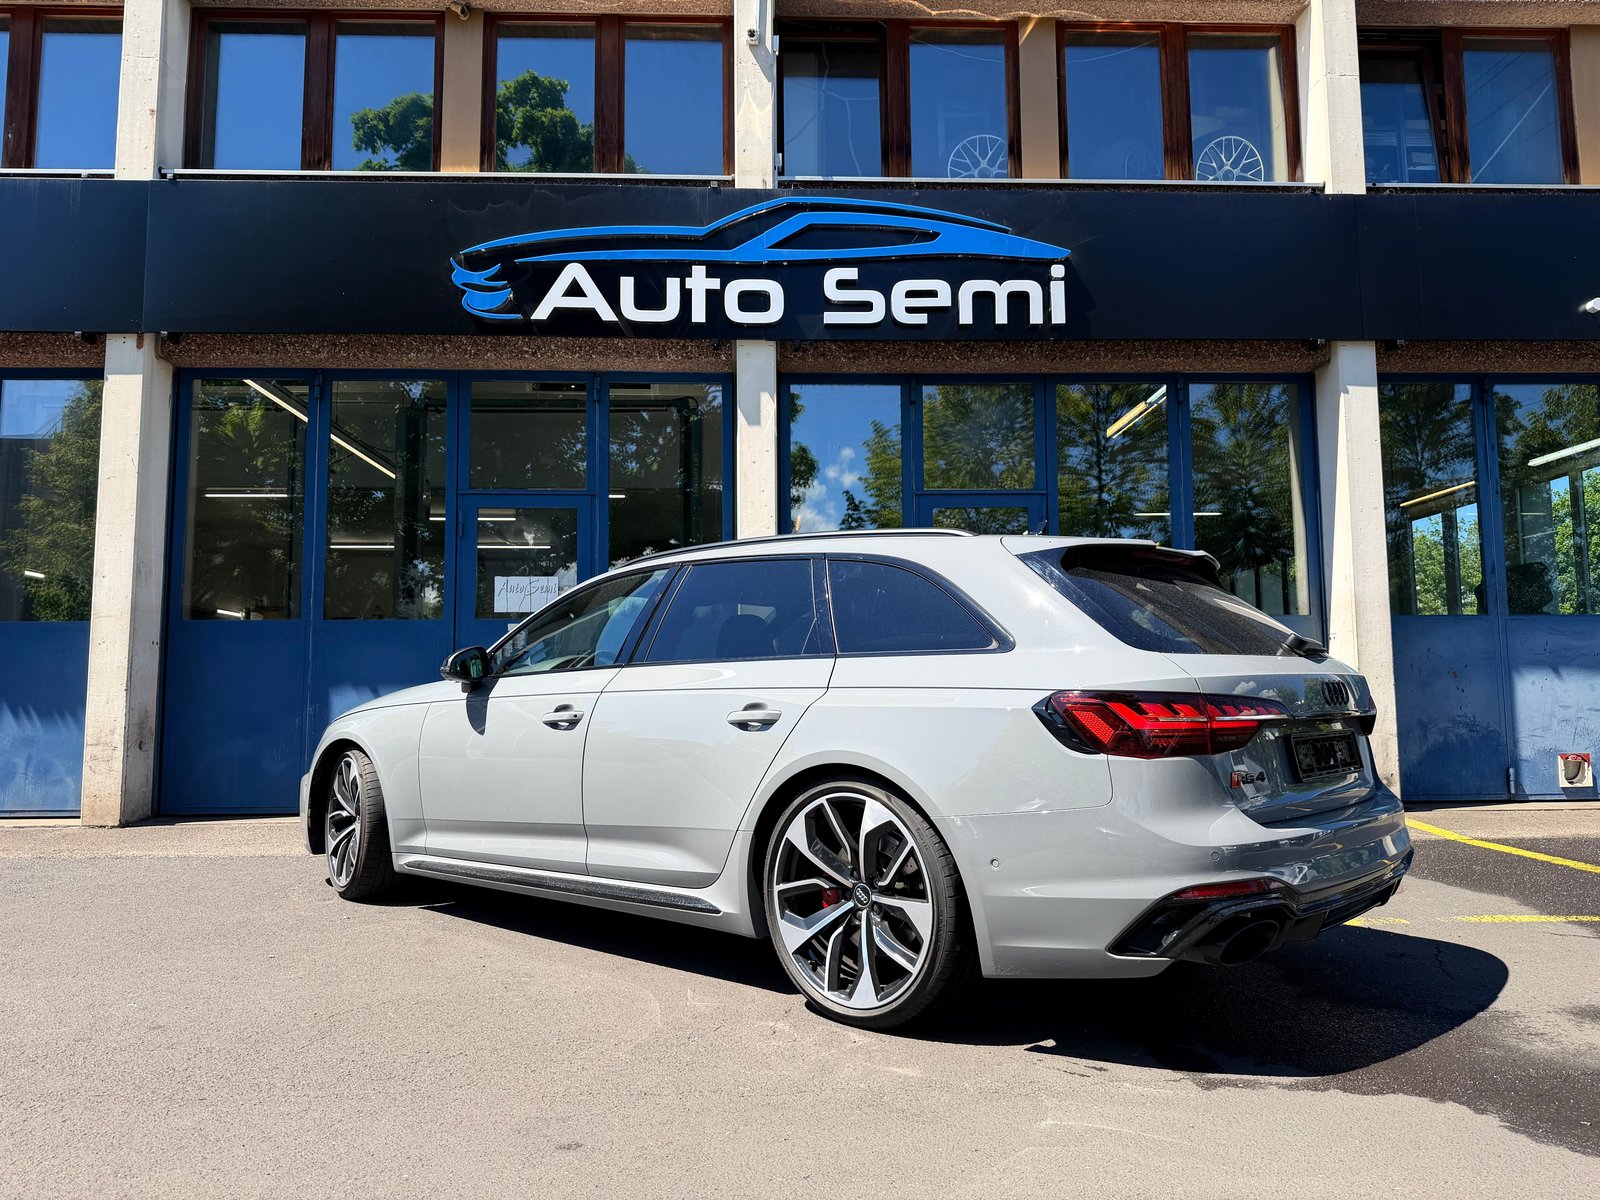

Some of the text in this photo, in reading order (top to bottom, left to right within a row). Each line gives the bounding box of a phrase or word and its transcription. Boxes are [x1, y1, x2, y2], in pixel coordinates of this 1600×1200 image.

[531, 262, 1067, 325] Auto Semi
[498, 578, 557, 597] Auto Semi
